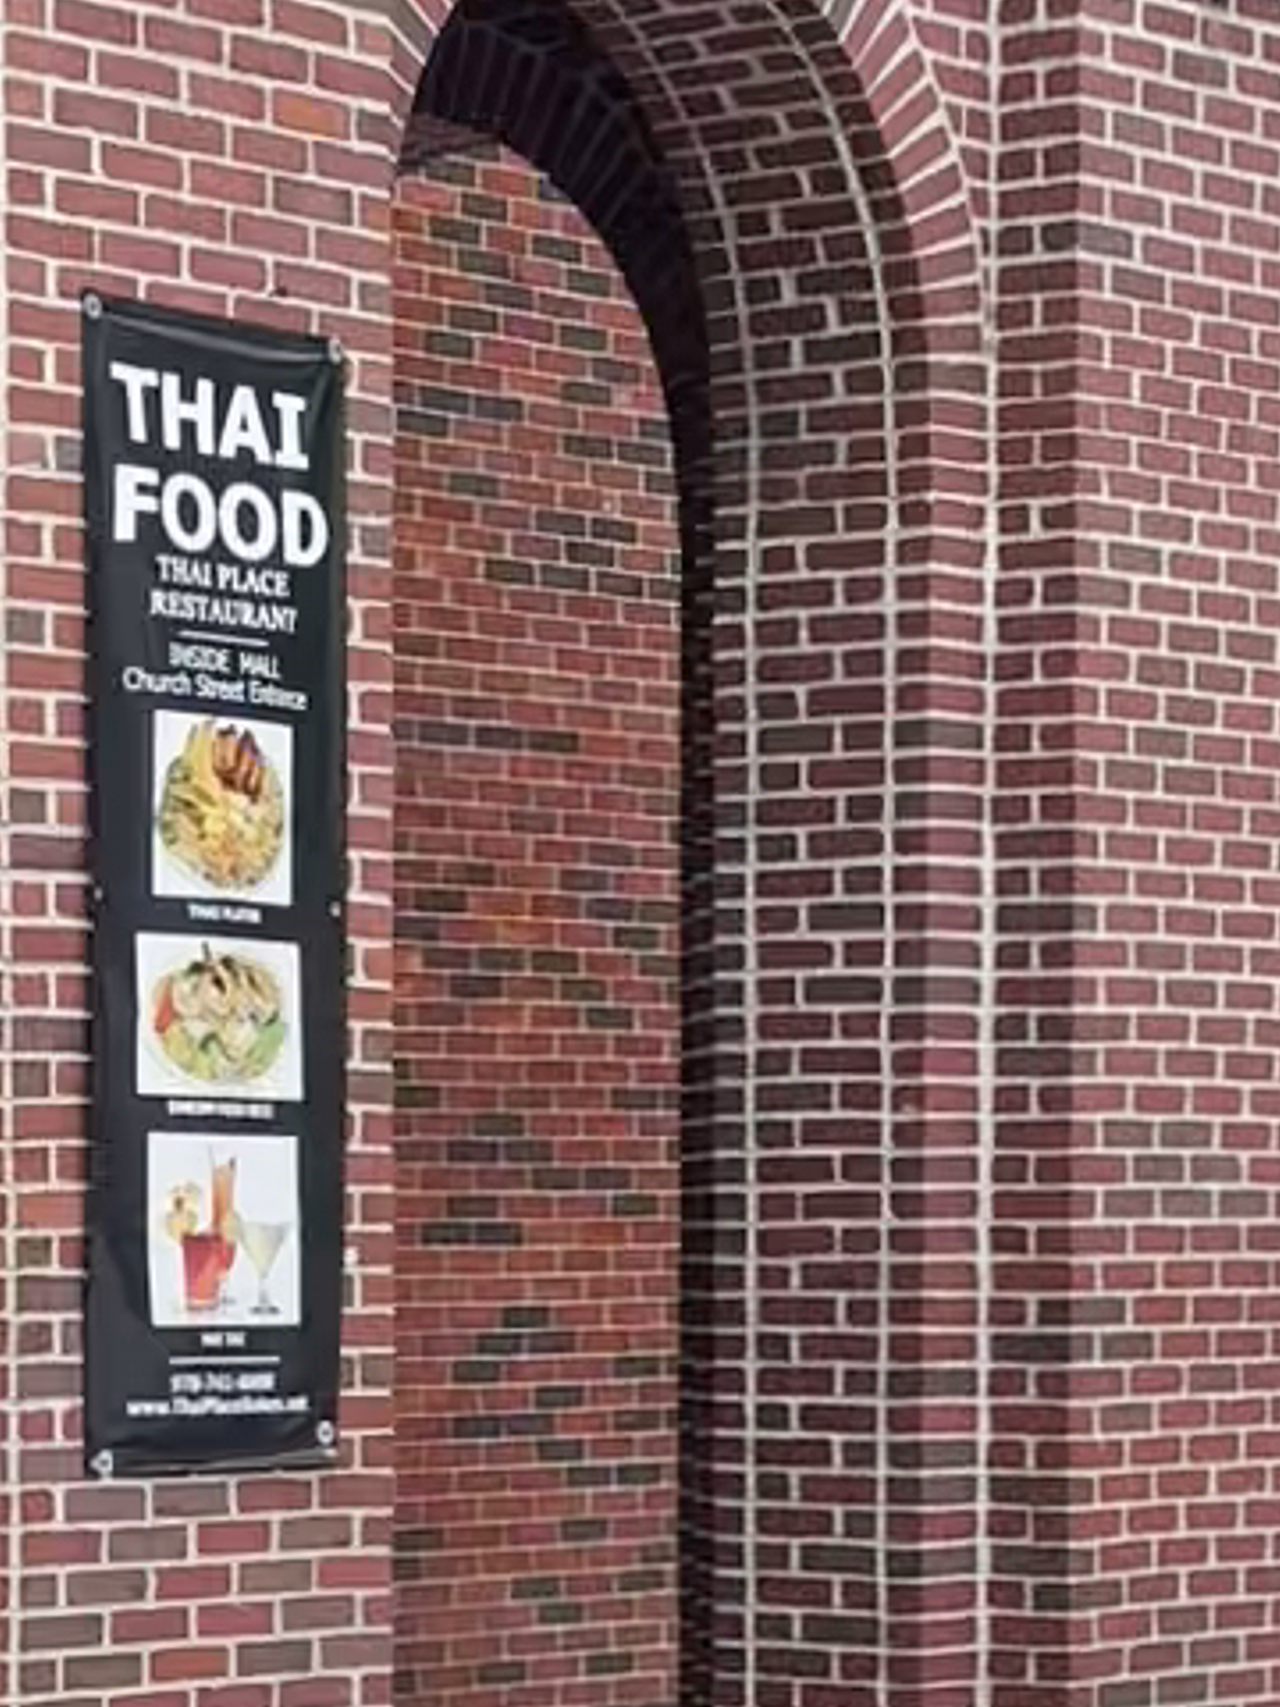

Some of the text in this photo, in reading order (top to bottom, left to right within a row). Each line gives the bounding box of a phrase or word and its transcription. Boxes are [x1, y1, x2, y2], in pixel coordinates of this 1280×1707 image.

[109, 360, 310, 470] THAI
[113, 463, 329, 569] FOOD
[154, 554, 291, 597] THAI PLACE
[149, 588, 299, 634] RESTAURANT
[168, 641, 231, 673] INSIDE
[121, 665, 192, 696] Church
